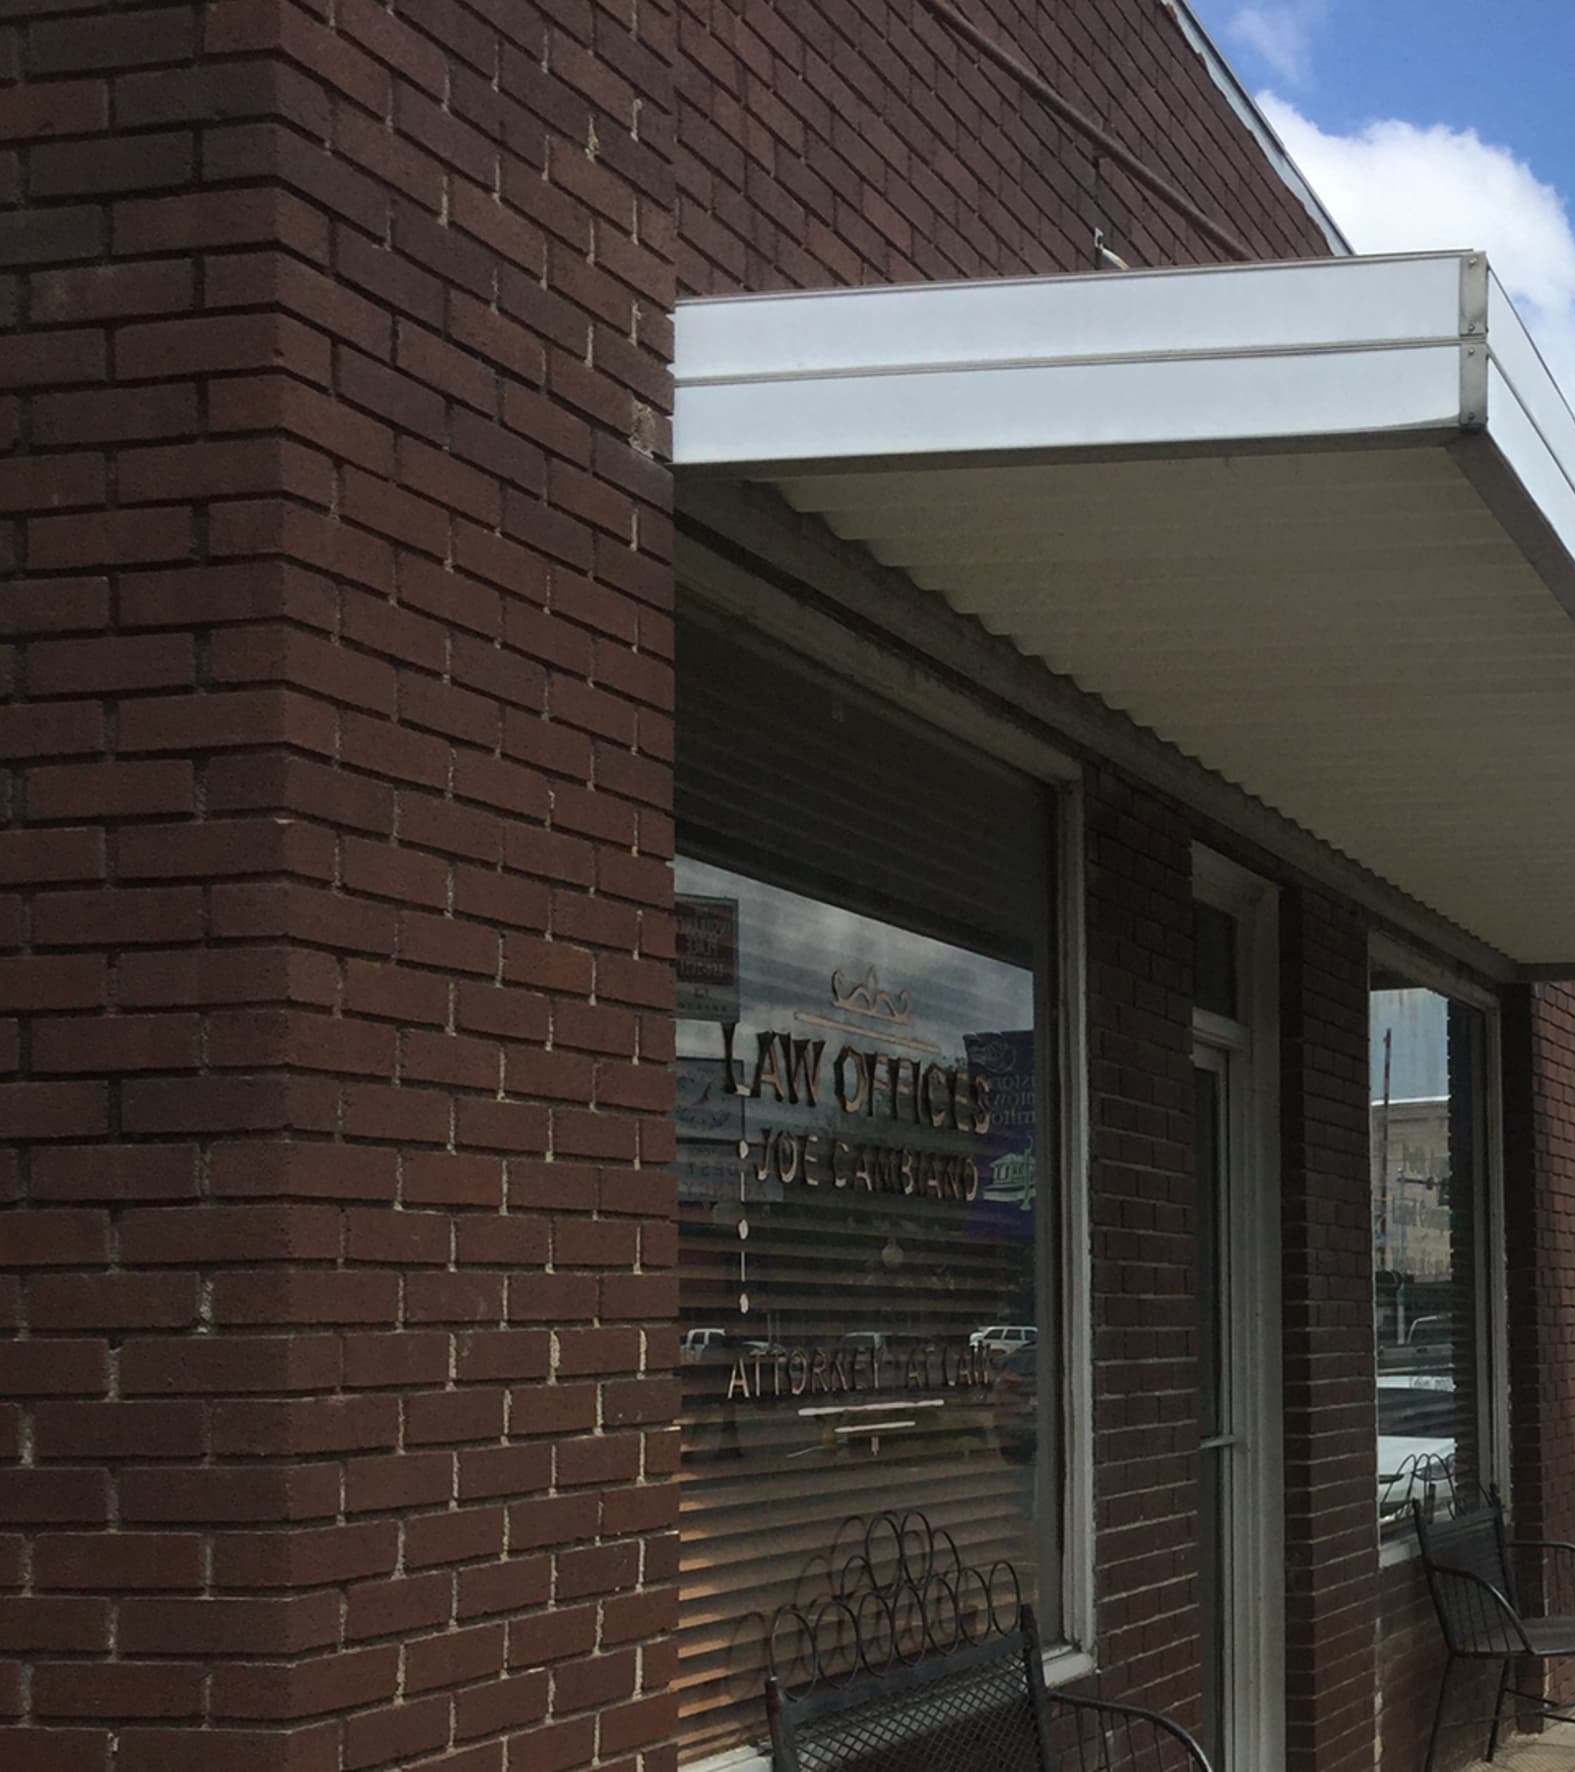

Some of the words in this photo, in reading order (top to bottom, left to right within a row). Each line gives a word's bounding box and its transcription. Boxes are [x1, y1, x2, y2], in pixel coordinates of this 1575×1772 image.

[721, 1022, 825, 1106] LAW
[833, 1044, 993, 1136] OFFICES
[755, 1128, 820, 1187] JOE
[727, 1344, 887, 1400] ATTORNEY
[906, 1344, 936, 1389] AT
